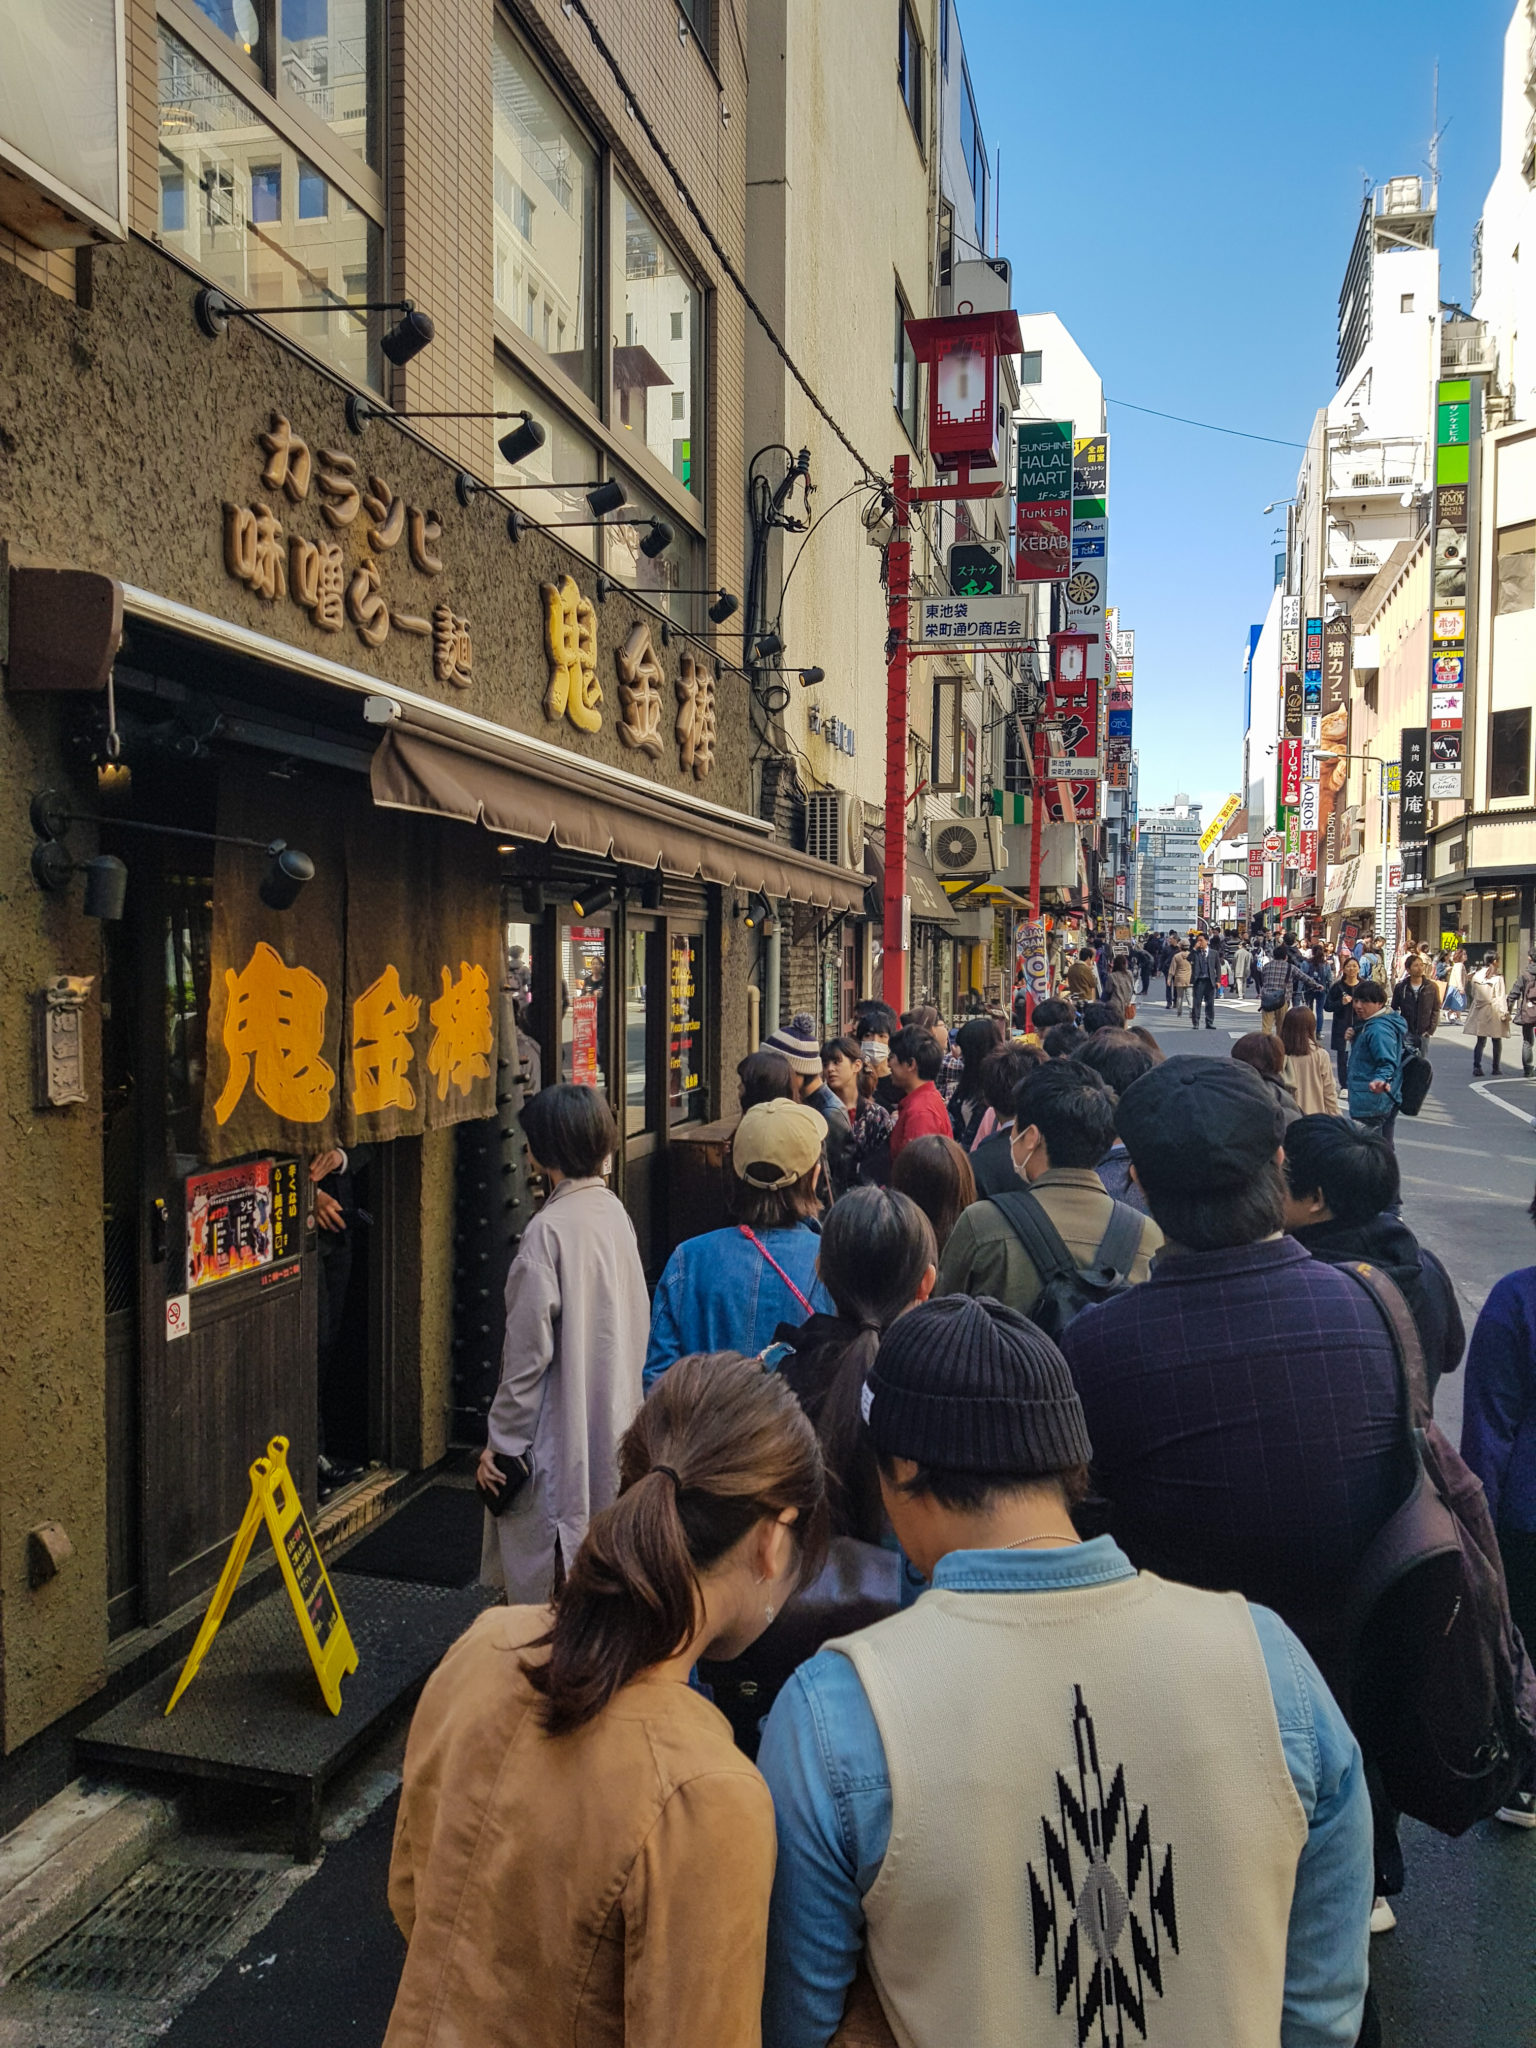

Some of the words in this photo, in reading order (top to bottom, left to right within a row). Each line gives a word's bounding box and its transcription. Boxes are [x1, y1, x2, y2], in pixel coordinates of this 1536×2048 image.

[1020, 441, 1071, 452] SUNSHINE
[1019, 453, 1070, 469] HALAL
[1022, 470, 1067, 486] MART
[258, 411, 445, 576] カラシビ
[1020, 506, 1068, 519] Turkish
[989, 546, 1001, 555] 3F
[1019, 534, 1068, 552] KEBAB
[956, 564, 998, 577] スナック
[1056, 564, 1068, 573] 1F
[925, 603, 968, 619] 東池袋
[1084, 605, 1101, 615] UP
[925, 620, 1022, 638] 栄町通り商店会
[540, 574, 717, 782] 鬼金棒
[1327, 641, 1345, 701] 猫カフェ
[1411, 744, 1421, 762] 焼肉
[1433, 741, 1446, 750] WA
[1445, 749, 1457, 757] YA
[1288, 740, 1298, 780] まーじゃん
[1302, 783, 1314, 827] AQROS
[214, 941, 493, 1125] 鬼金棒
